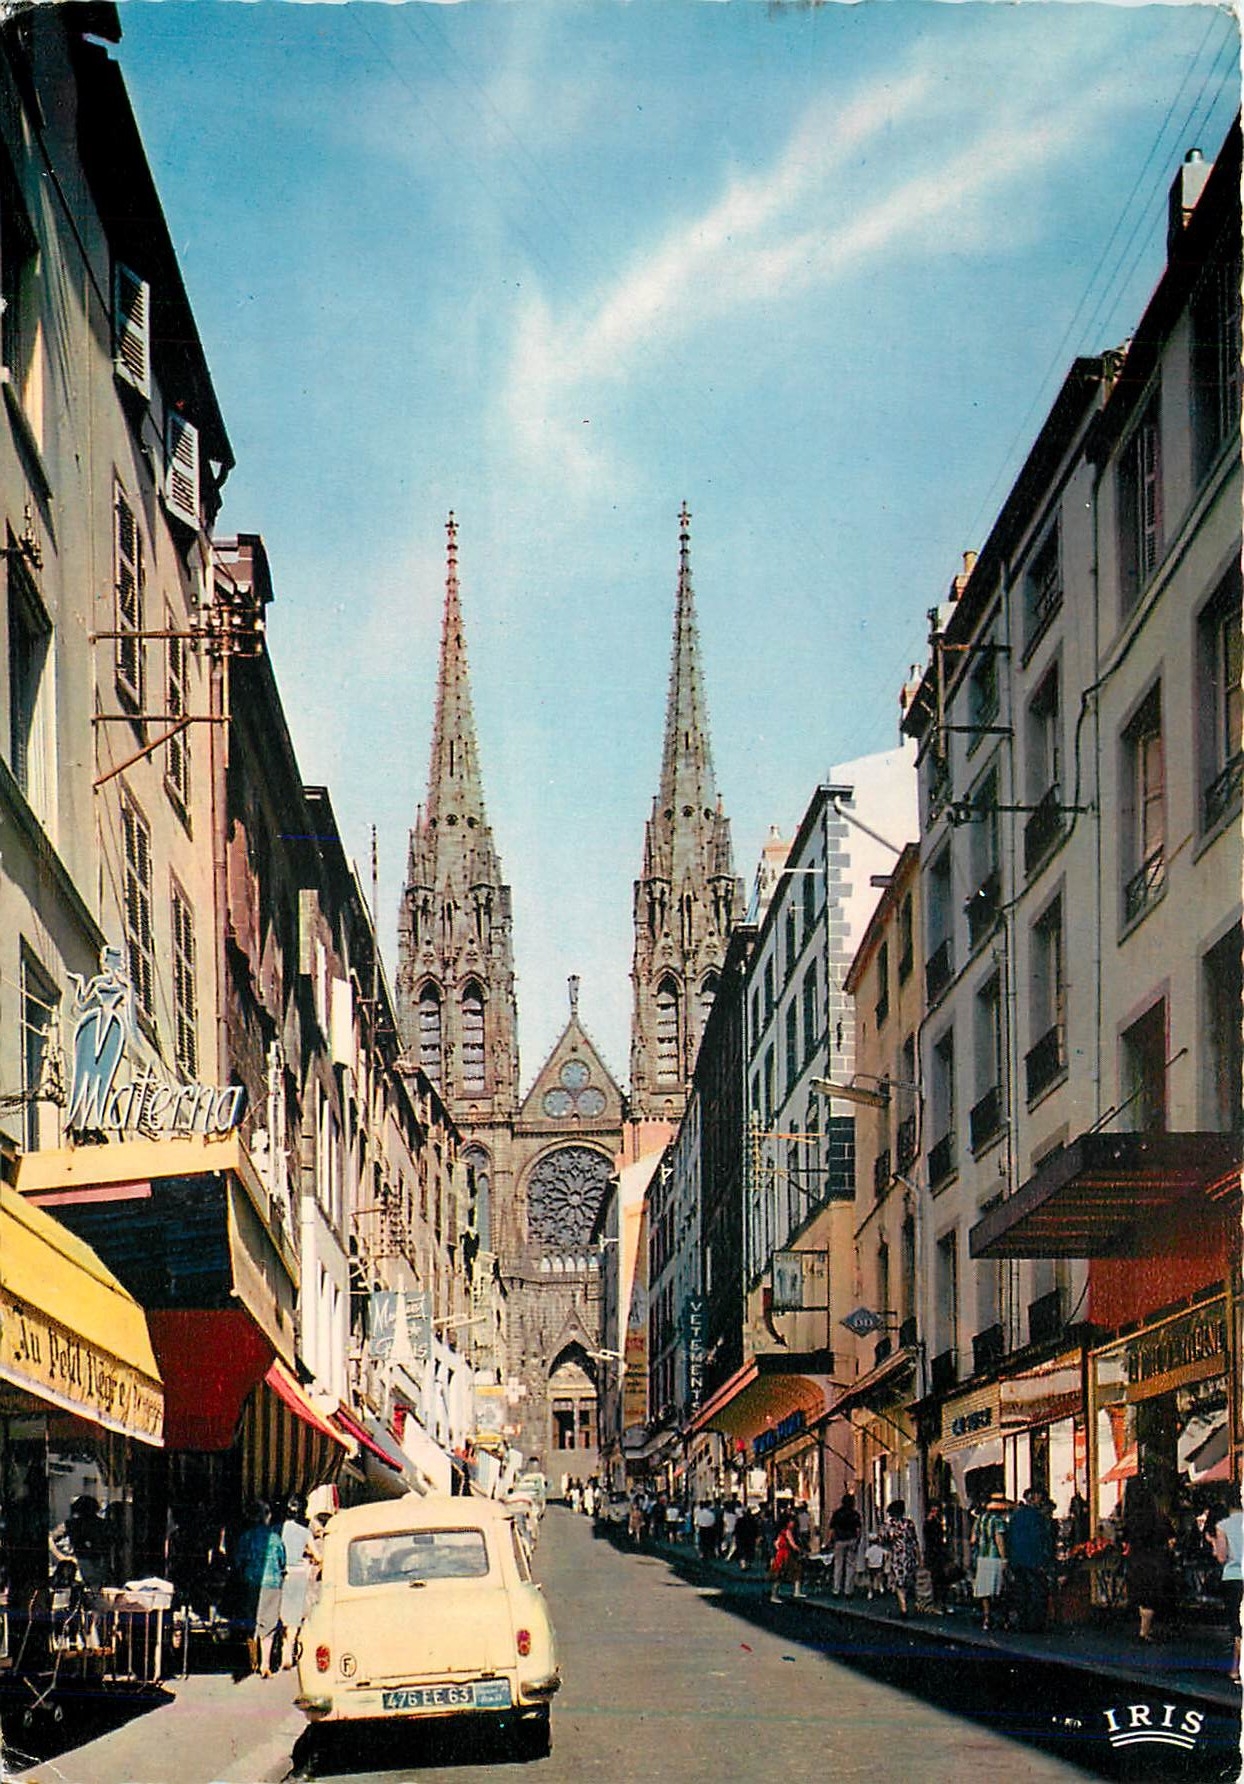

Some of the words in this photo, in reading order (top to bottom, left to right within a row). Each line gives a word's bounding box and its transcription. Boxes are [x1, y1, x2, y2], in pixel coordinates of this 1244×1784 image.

[63, 1062, 243, 1134] Materna
[343, 1657, 351, 1673] F
[385, 1690, 418, 1709] 476
[422, 1690, 446, 1706] EE
[449, 1687, 469, 1704] 63
